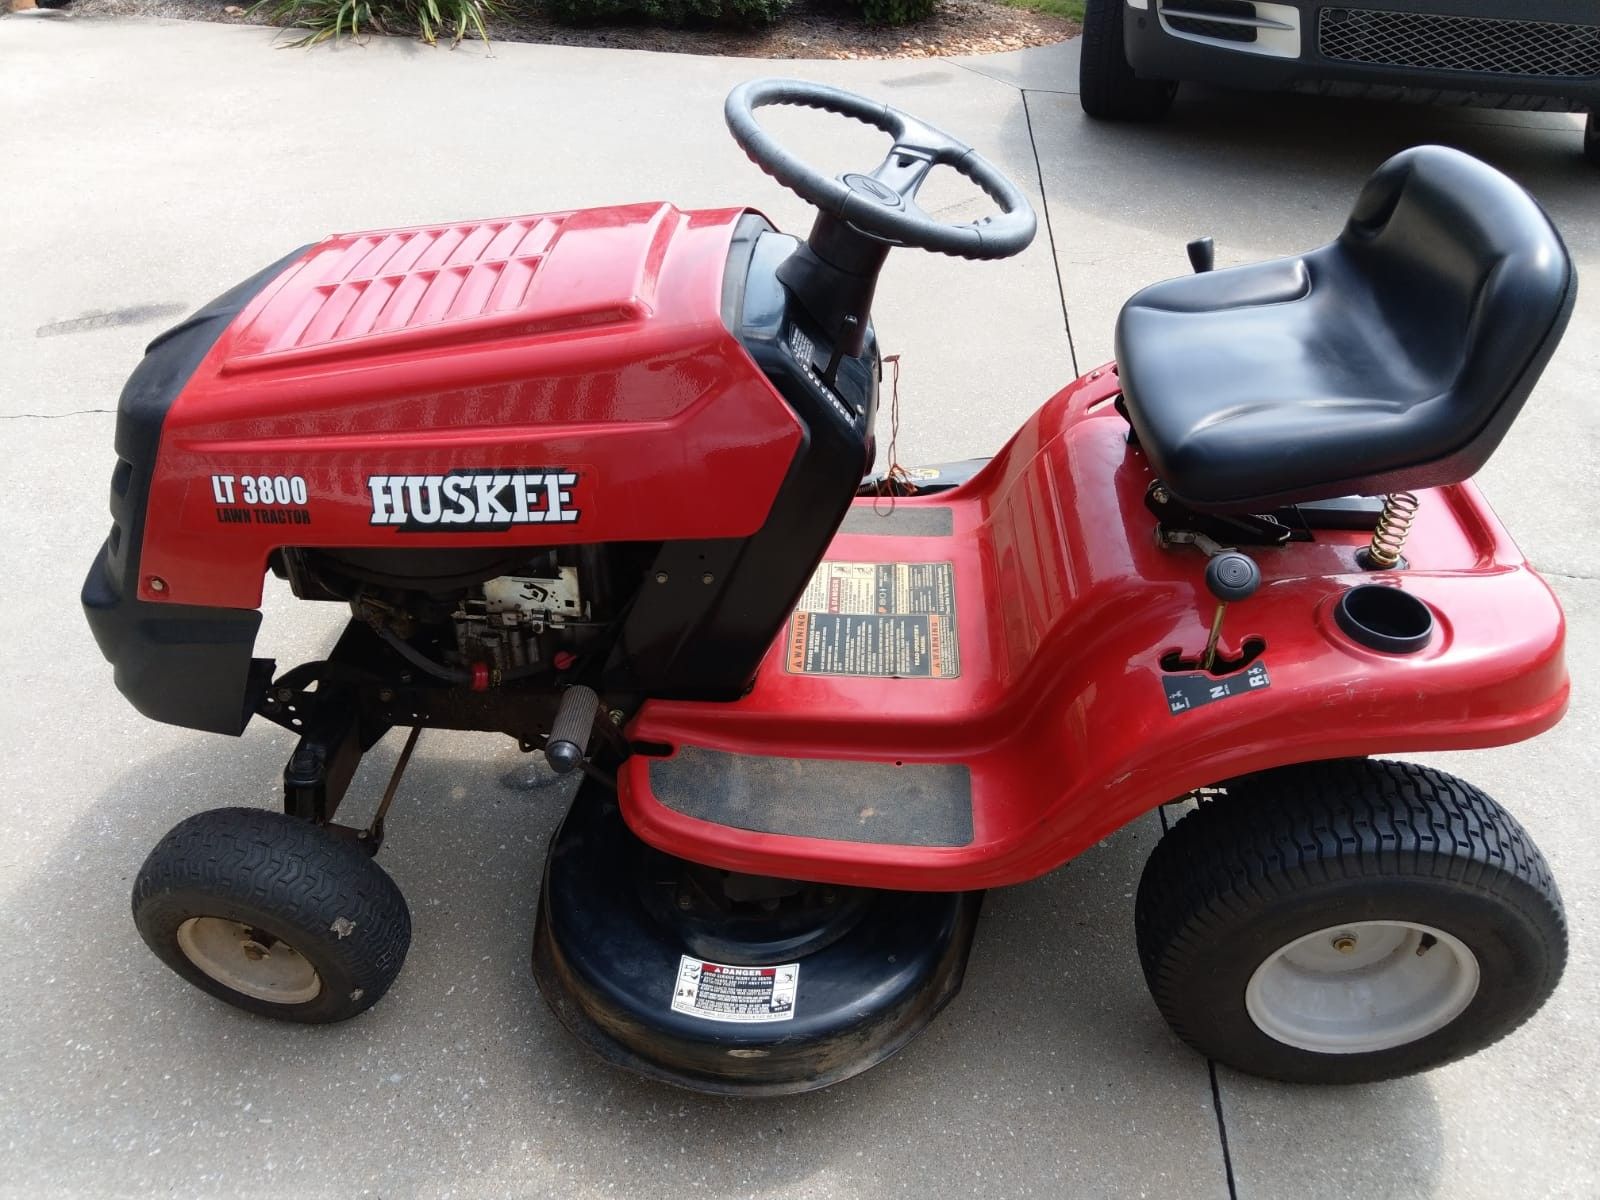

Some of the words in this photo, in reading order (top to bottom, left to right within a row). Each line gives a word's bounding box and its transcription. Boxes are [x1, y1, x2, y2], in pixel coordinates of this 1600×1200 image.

[212, 475, 235, 504] LT
[241, 475, 308, 505] 3800
[367, 473, 579, 524] HUSKEE
[216, 508, 252, 524] LAWN
[253, 508, 312, 525] TRACTOR
[794, 614, 806, 659] WARNING
[931, 622, 939, 660] WARNING
[1249, 675, 1264, 687] R
[1209, 685, 1225, 699] N
[1171, 701, 1185, 711] F
[722, 967, 762, 976] DANGER
